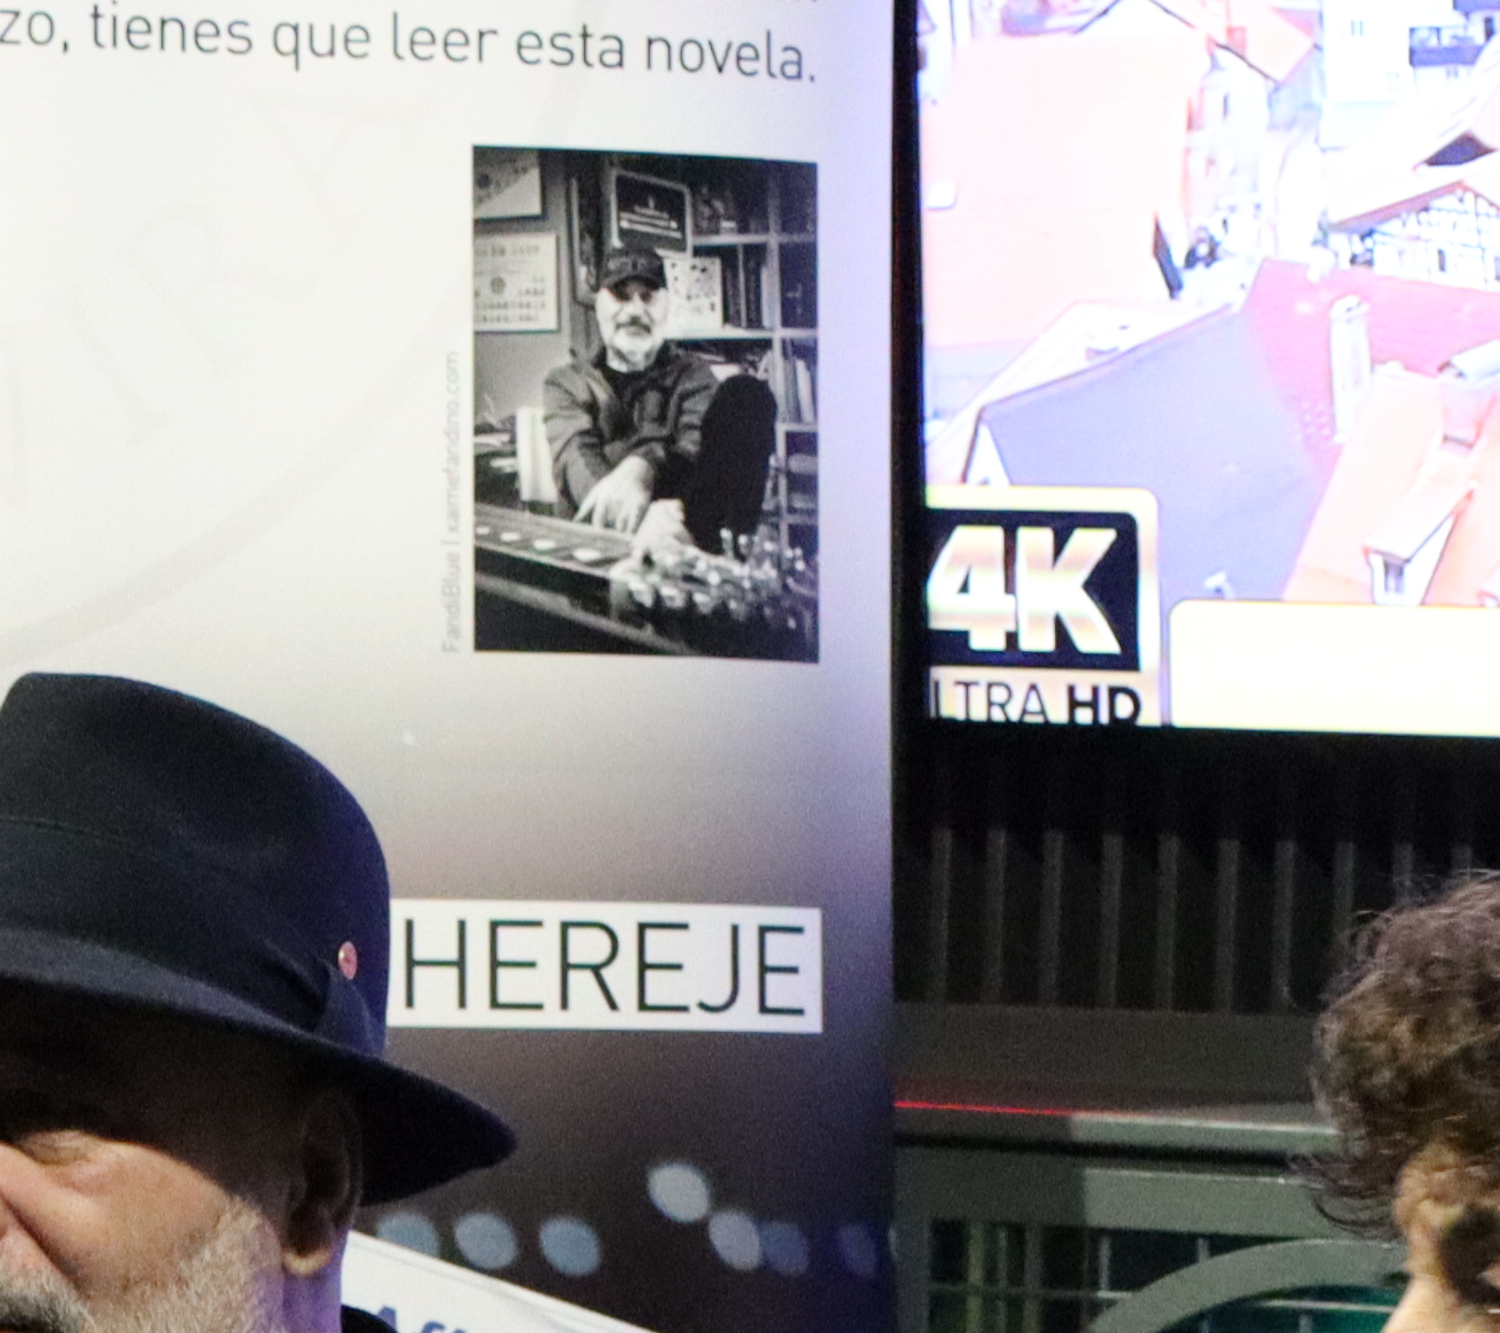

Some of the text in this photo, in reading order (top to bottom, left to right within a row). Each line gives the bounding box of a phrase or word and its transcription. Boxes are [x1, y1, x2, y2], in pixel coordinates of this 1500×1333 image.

[90, 0, 253, 55] tienes
[272, 21, 371, 72] que
[392, 11, 499, 64] leer
[515, 23, 625, 70] esta
[645, 29, 816, 84] novela.
[927, 524, 1122, 655] 4K
[1067, 683, 1142, 724] HD
[404, 918, 806, 1016] HEREJE
